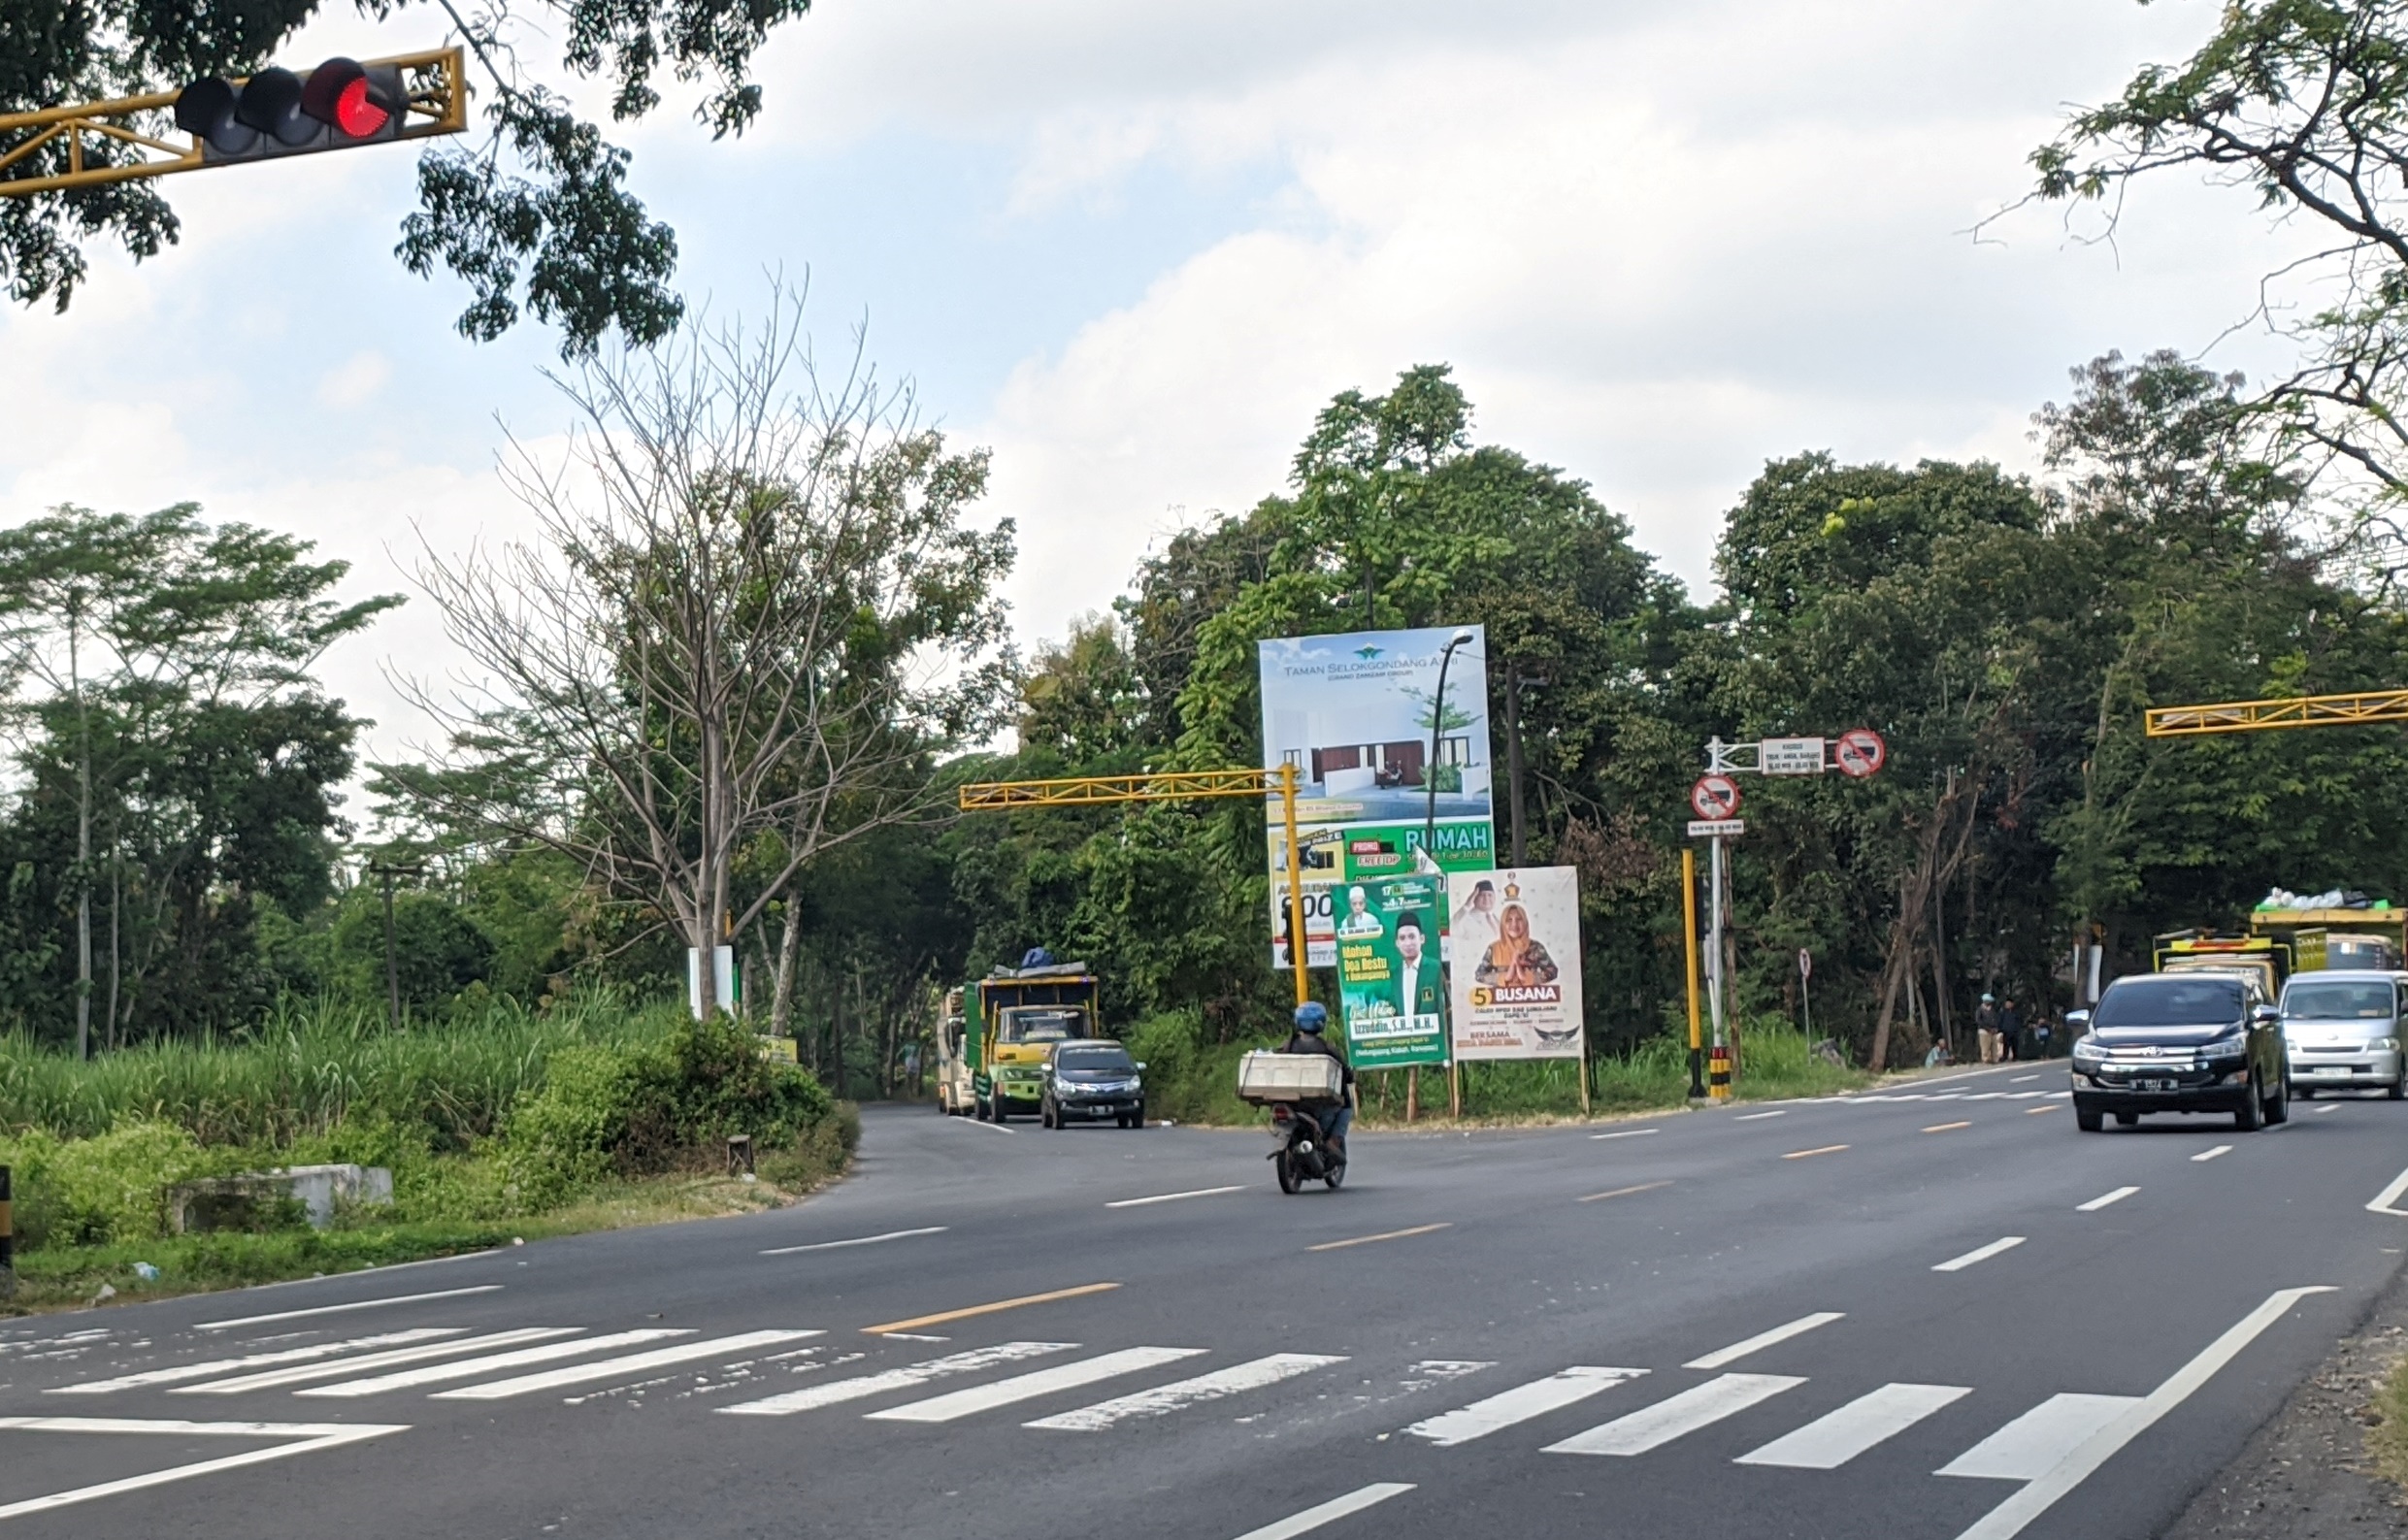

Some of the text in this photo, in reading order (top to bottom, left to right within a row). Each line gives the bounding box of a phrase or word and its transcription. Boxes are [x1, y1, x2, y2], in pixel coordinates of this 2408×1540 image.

[1284, 667, 1326, 677] TAMAN
[1328, 659, 1428, 674] SELOKGONDANG
[1405, 827, 1488, 852] RUMAH
[1474, 986, 1557, 1005] 5 BUSANA
[1470, 1031, 1511, 1039] BERSAMA
